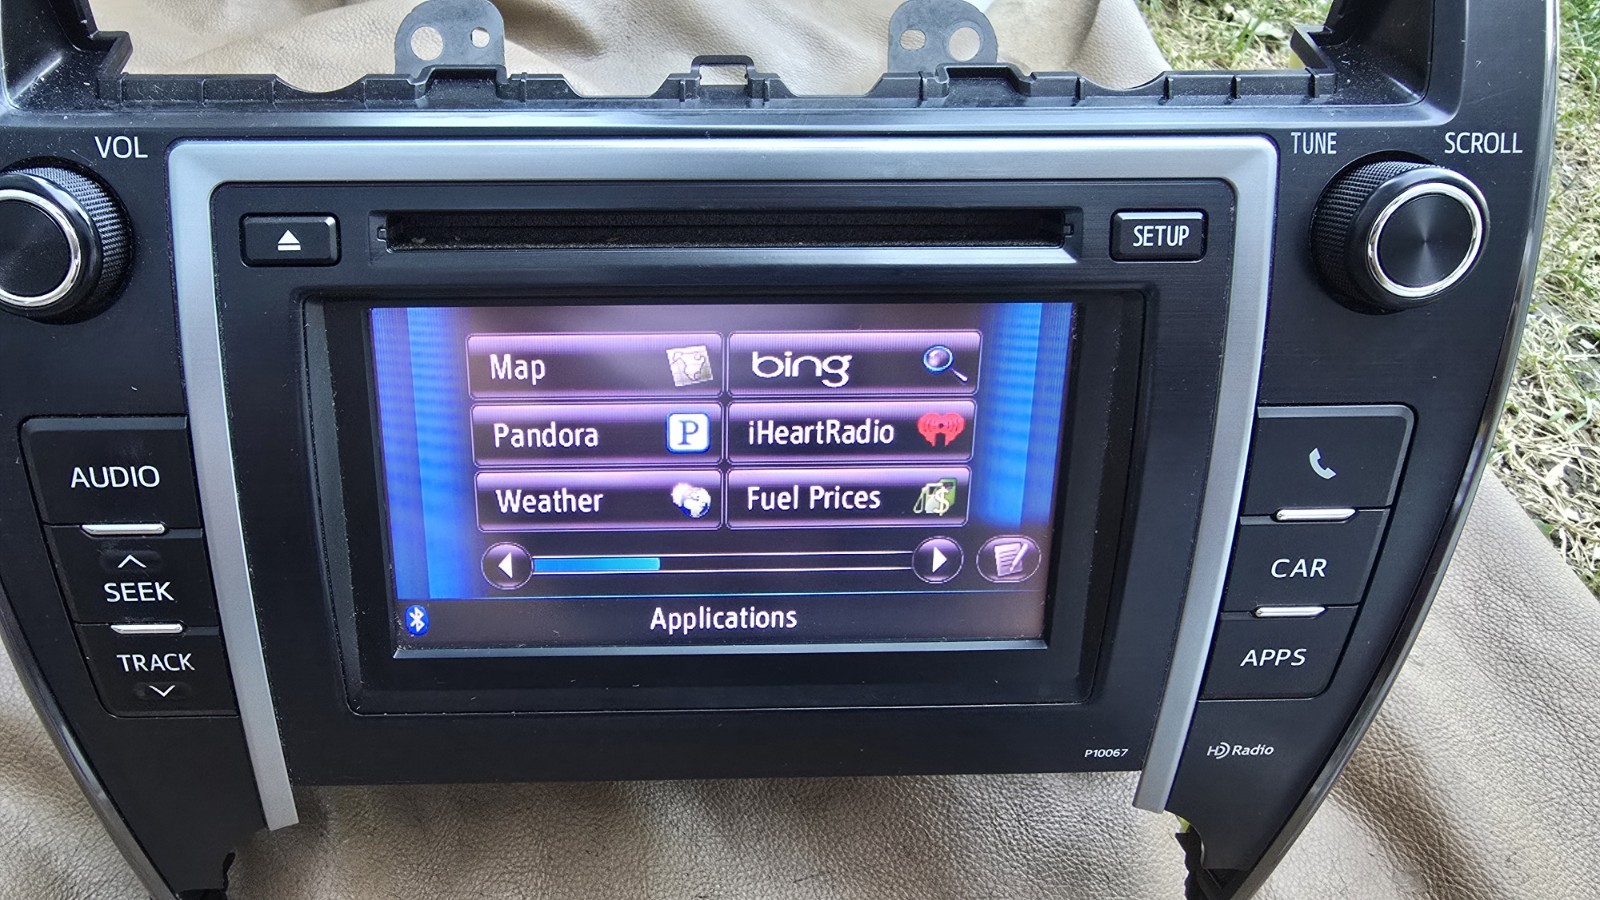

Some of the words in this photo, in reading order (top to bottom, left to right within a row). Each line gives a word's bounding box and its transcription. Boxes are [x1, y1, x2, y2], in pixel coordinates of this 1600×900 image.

[94, 135, 149, 159] VOL
[1290, 131, 1337, 155] TUNE
[1444, 131, 1523, 154] SCROLL
[1132, 225, 1190, 247] SETUP
[489, 353, 546, 386] Map
[751, 350, 853, 388] bing
[493, 420, 599, 448] Pandora
[679, 419, 699, 445] P
[748, 417, 895, 445] iHeartRadio
[70, 465, 160, 488] AUDIO
[495, 487, 604, 513] Weather
[747, 484, 799, 511] Fuel
[809, 485, 881, 510] Prices
[1270, 558, 1327, 578] CAR
[103, 581, 175, 603] SEEK
[650, 605, 798, 635] Applications
[116, 653, 195, 672] TRACK
[1239, 648, 1307, 667] APPS
[1084, 748, 1129, 758] P10067
[1231, 744, 1276, 757] Radio
